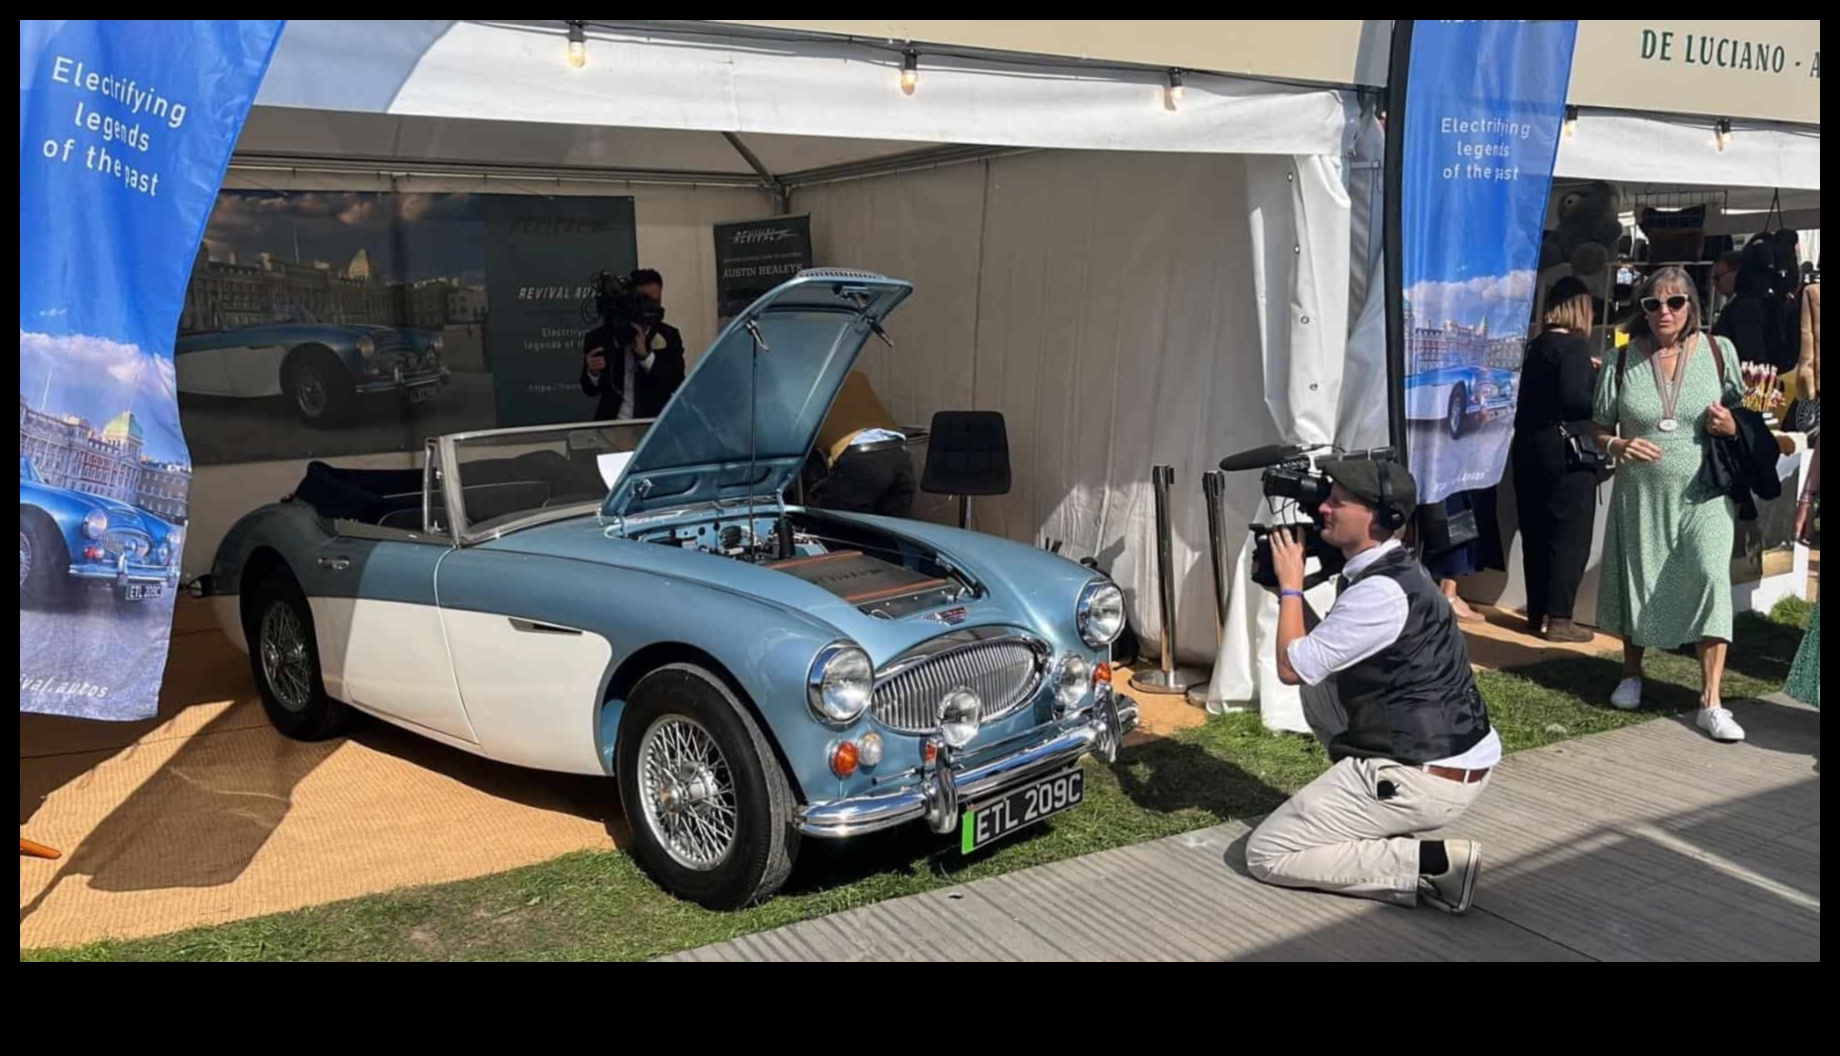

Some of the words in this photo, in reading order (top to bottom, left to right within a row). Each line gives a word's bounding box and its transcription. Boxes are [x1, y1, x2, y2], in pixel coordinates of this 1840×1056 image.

[1641, 29, 1674, 61] DE
[1685, 34, 1785, 73] LUCIANO
[53, 56, 186, 128] Electrifying
[75, 102, 150, 152] legends
[1441, 117, 1531, 139] Electrifying
[1457, 141, 1510, 160] legends
[43, 139, 75, 162] of
[86, 145, 122, 176] the
[124, 165, 159, 196] past
[1443, 163, 1460, 179] of
[1466, 163, 1492, 179] the
[723, 266, 757, 280] AUSTIN
[758, 263, 802, 276] HEALEYS
[518, 286, 570, 301] REVIVAL
[977, 799, 1019, 843] ETL
[1024, 773, 1081, 820] 209C
